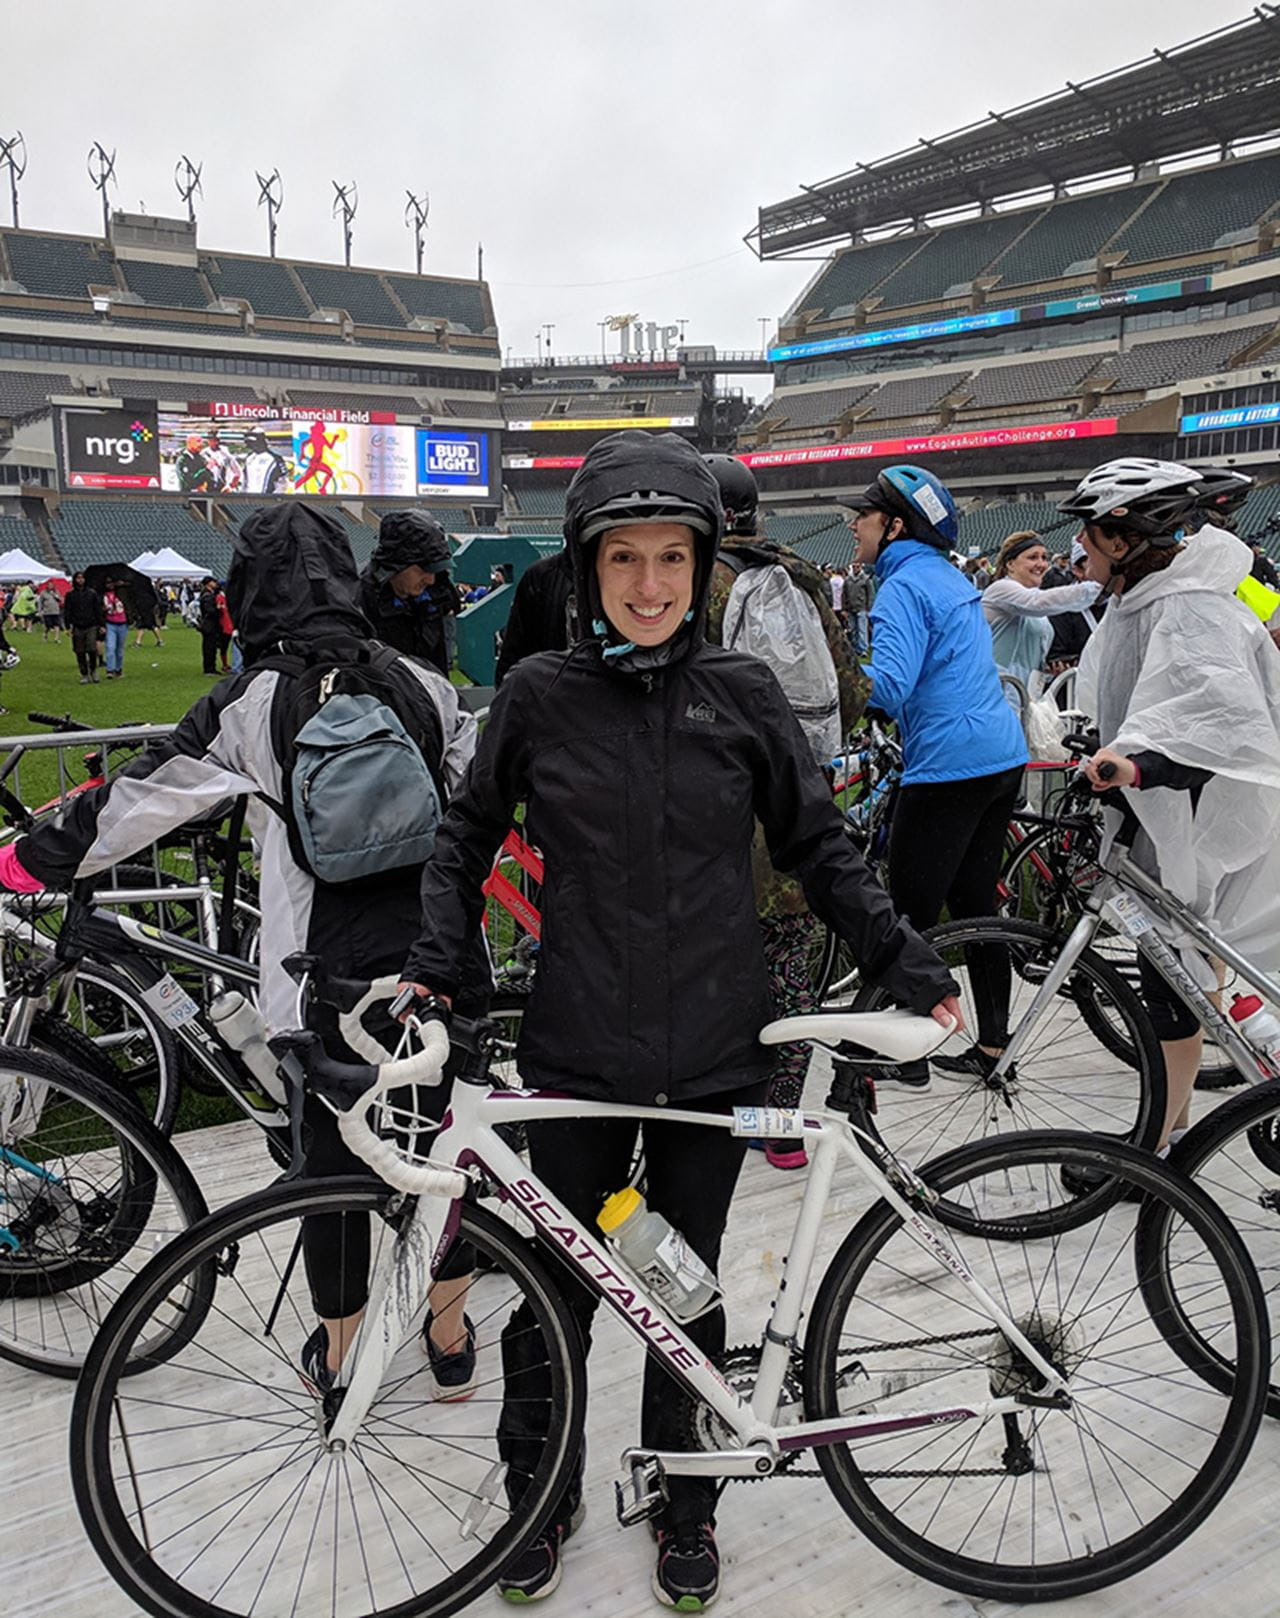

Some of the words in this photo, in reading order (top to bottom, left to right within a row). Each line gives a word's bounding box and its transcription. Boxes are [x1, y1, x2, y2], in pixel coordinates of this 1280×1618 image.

[232, 404, 279, 419] Lincoln
[282, 406, 337, 422] Financial
[341, 409, 370, 423] Field
[1198, 411, 1244, 427] ADVANCING
[1245, 407, 1280, 421] AUTISM
[906, 427, 1077, 450] www.EaglesAutismChallenge.org
[435, 444, 470, 457] BUD
[750, 454, 783, 465] ADVANCING
[784, 451, 807, 461] AUTISM
[808, 448, 839, 459] RESEARCH
[840, 445, 873, 456] TOGETHER
[429, 457, 477, 471] LIGHT
[910, 1216, 973, 1283] SCATTANTE
[510, 1179, 700, 1371] SCATTANTE
